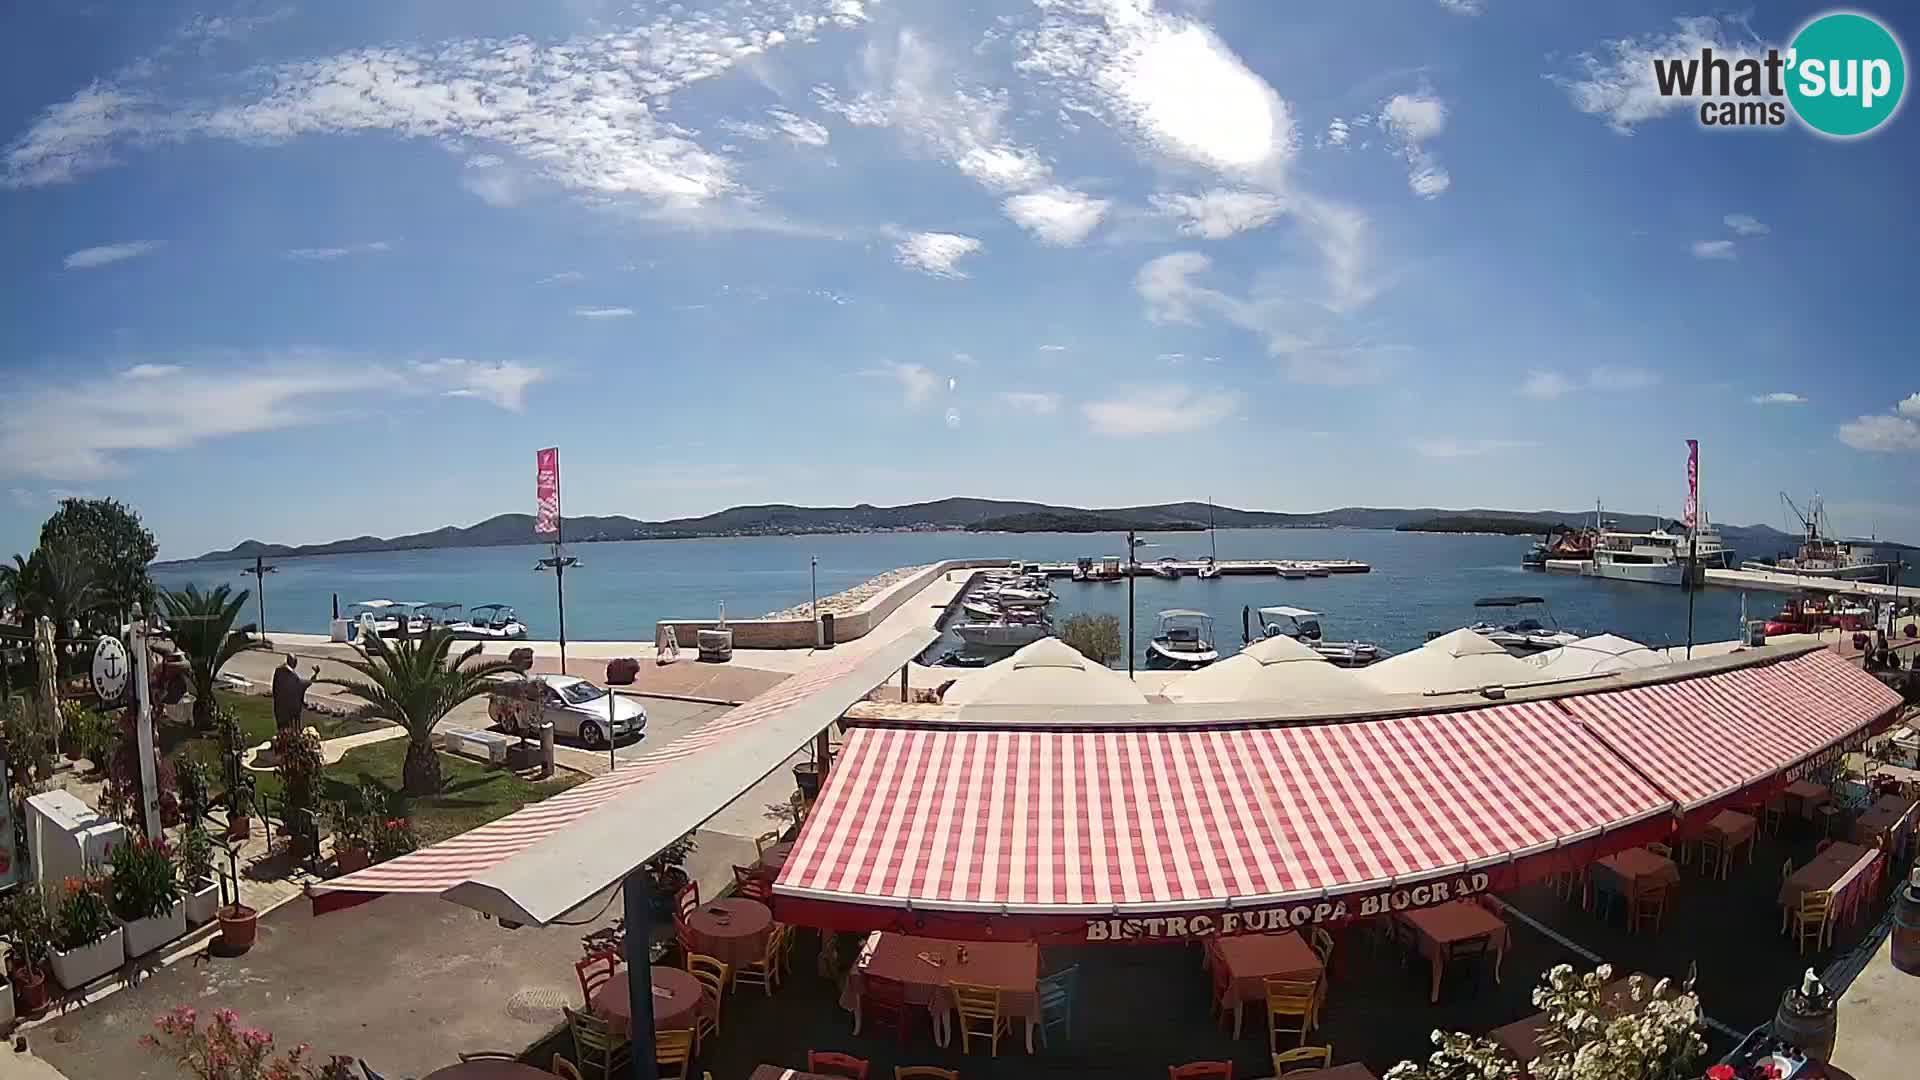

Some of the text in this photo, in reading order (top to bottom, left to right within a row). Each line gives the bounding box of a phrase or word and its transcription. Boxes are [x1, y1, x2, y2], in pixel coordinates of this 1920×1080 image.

[1086, 873, 1488, 940] BISTRO EUROPA BIOGRAD
